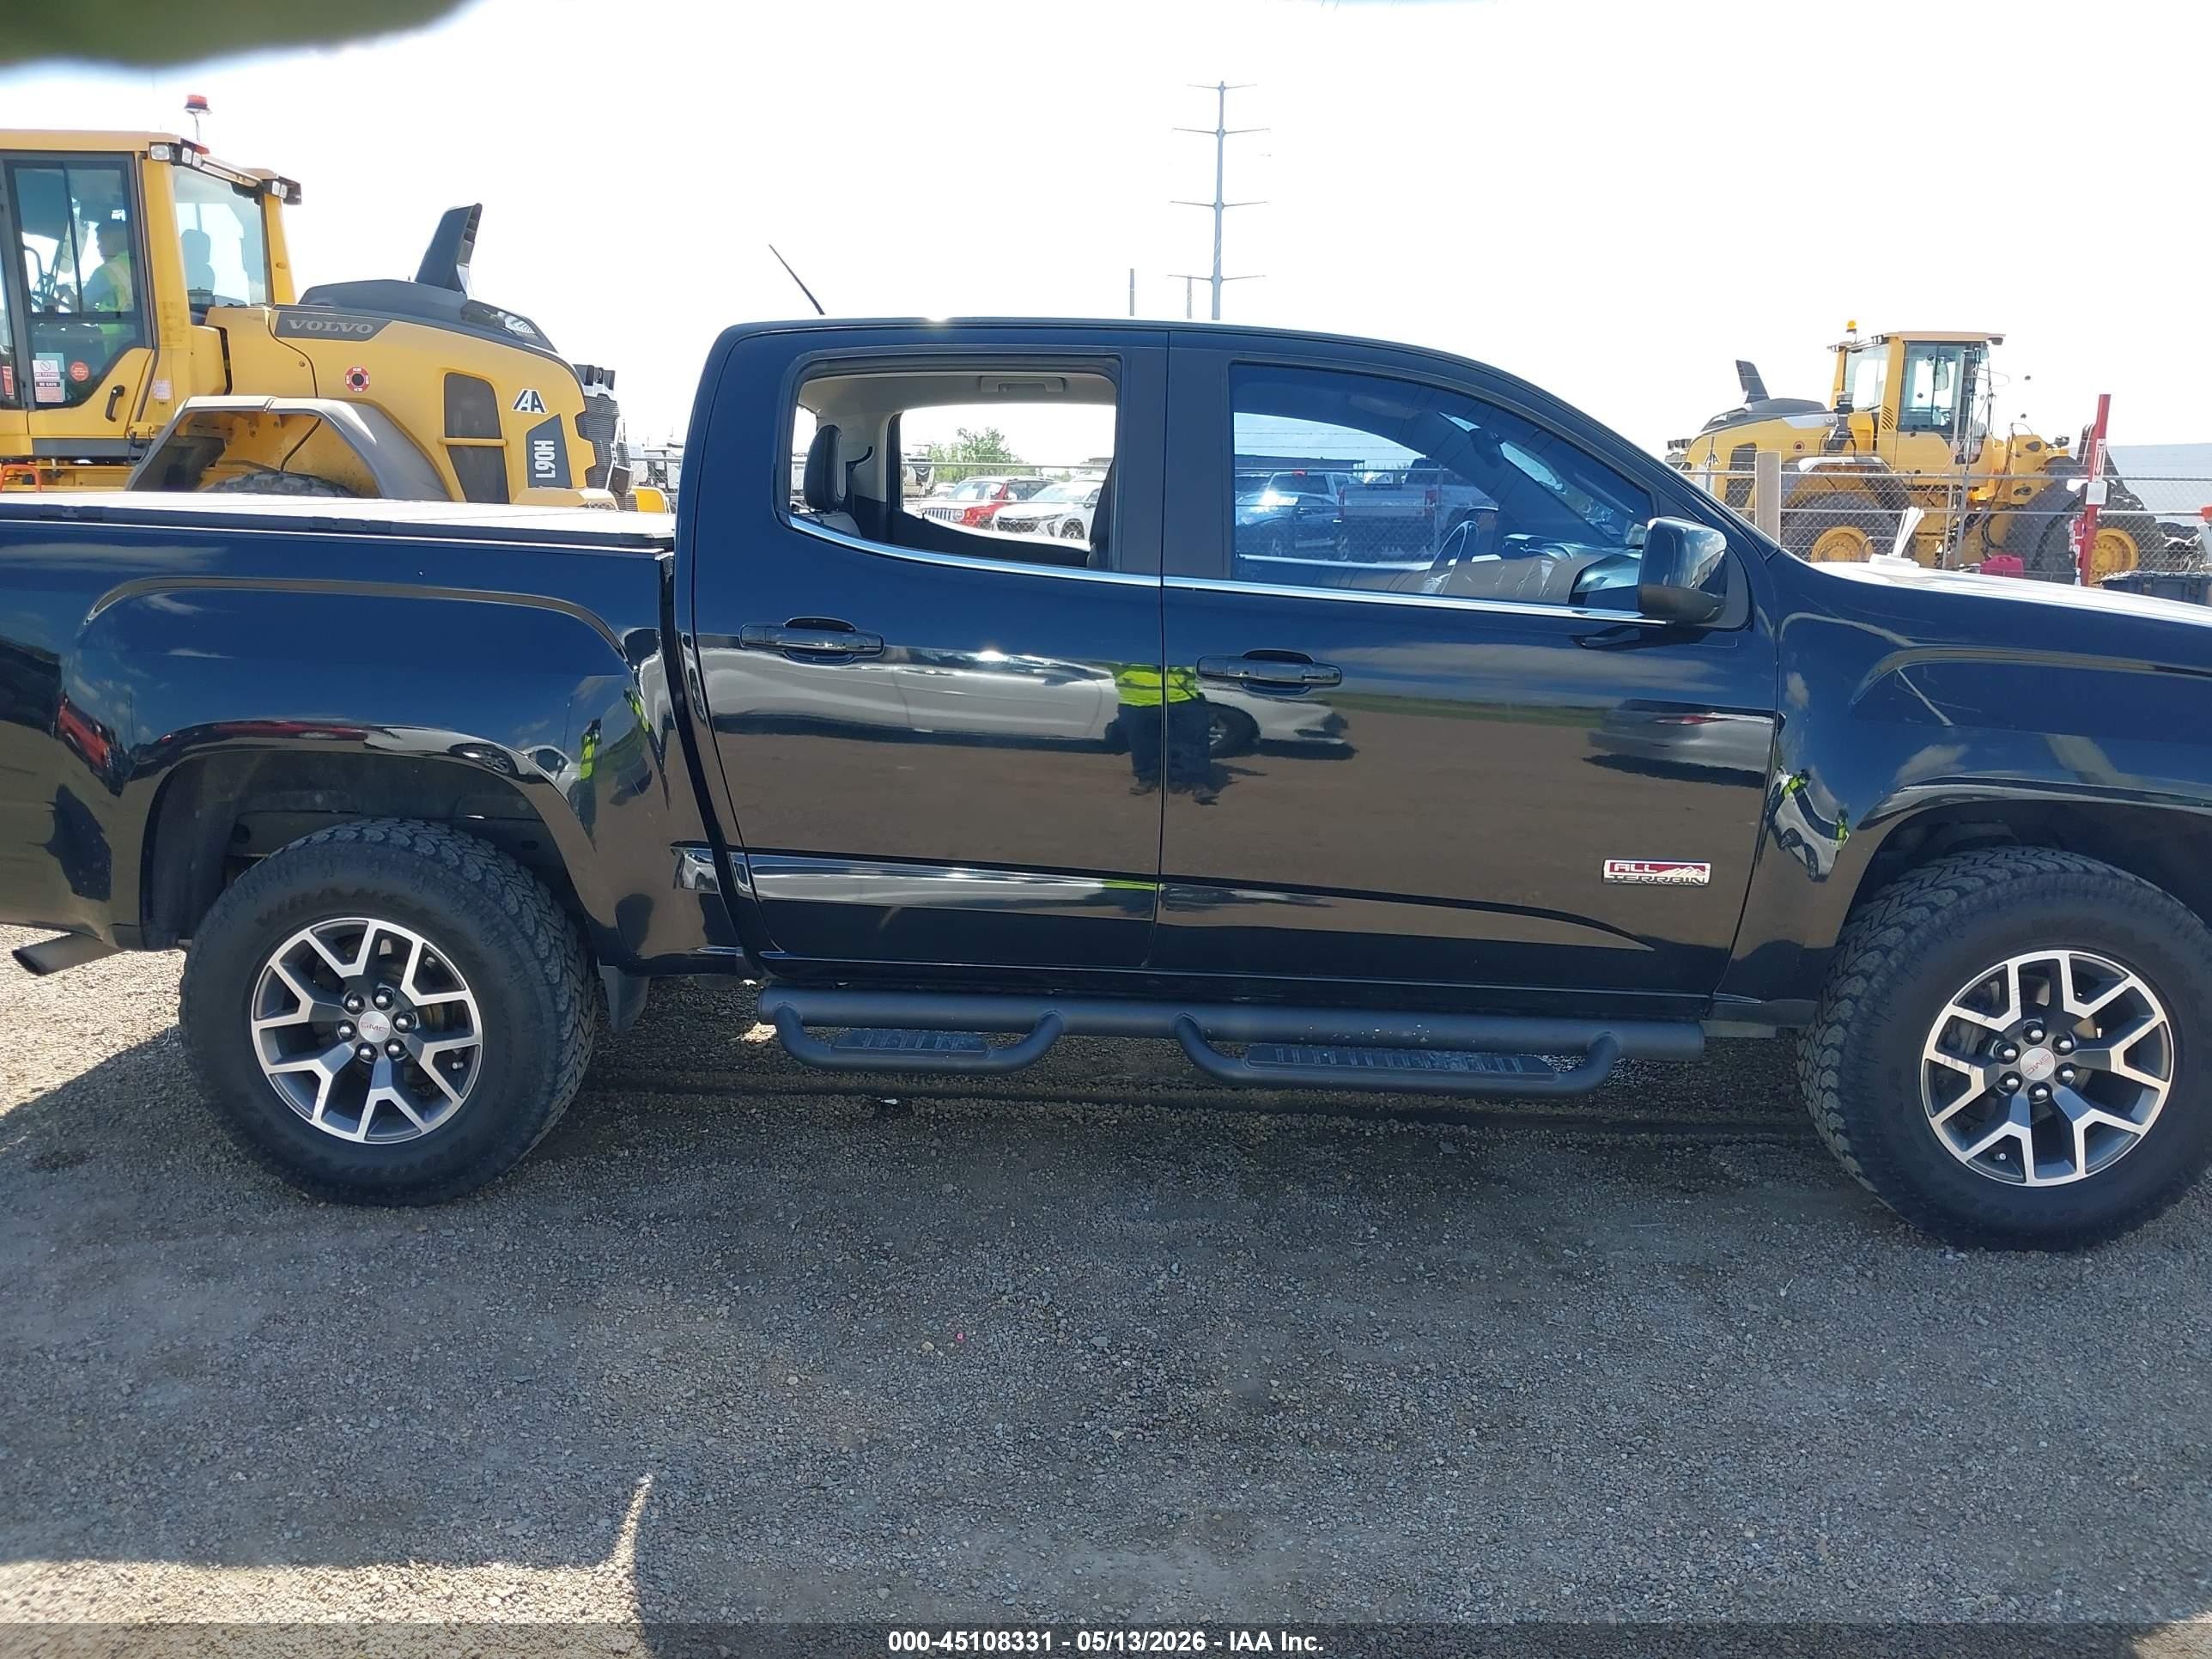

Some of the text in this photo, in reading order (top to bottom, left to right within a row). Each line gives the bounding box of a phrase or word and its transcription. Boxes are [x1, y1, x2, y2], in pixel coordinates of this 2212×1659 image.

[289, 319, 374, 334] VOLVO
[534, 440, 556, 478] L90H
[1613, 863, 1657, 872] ALL
[1605, 874, 1706, 885] TERRAIN
[361, 1022, 386, 1032] GMC
[2025, 1053, 2051, 1076] GMC
